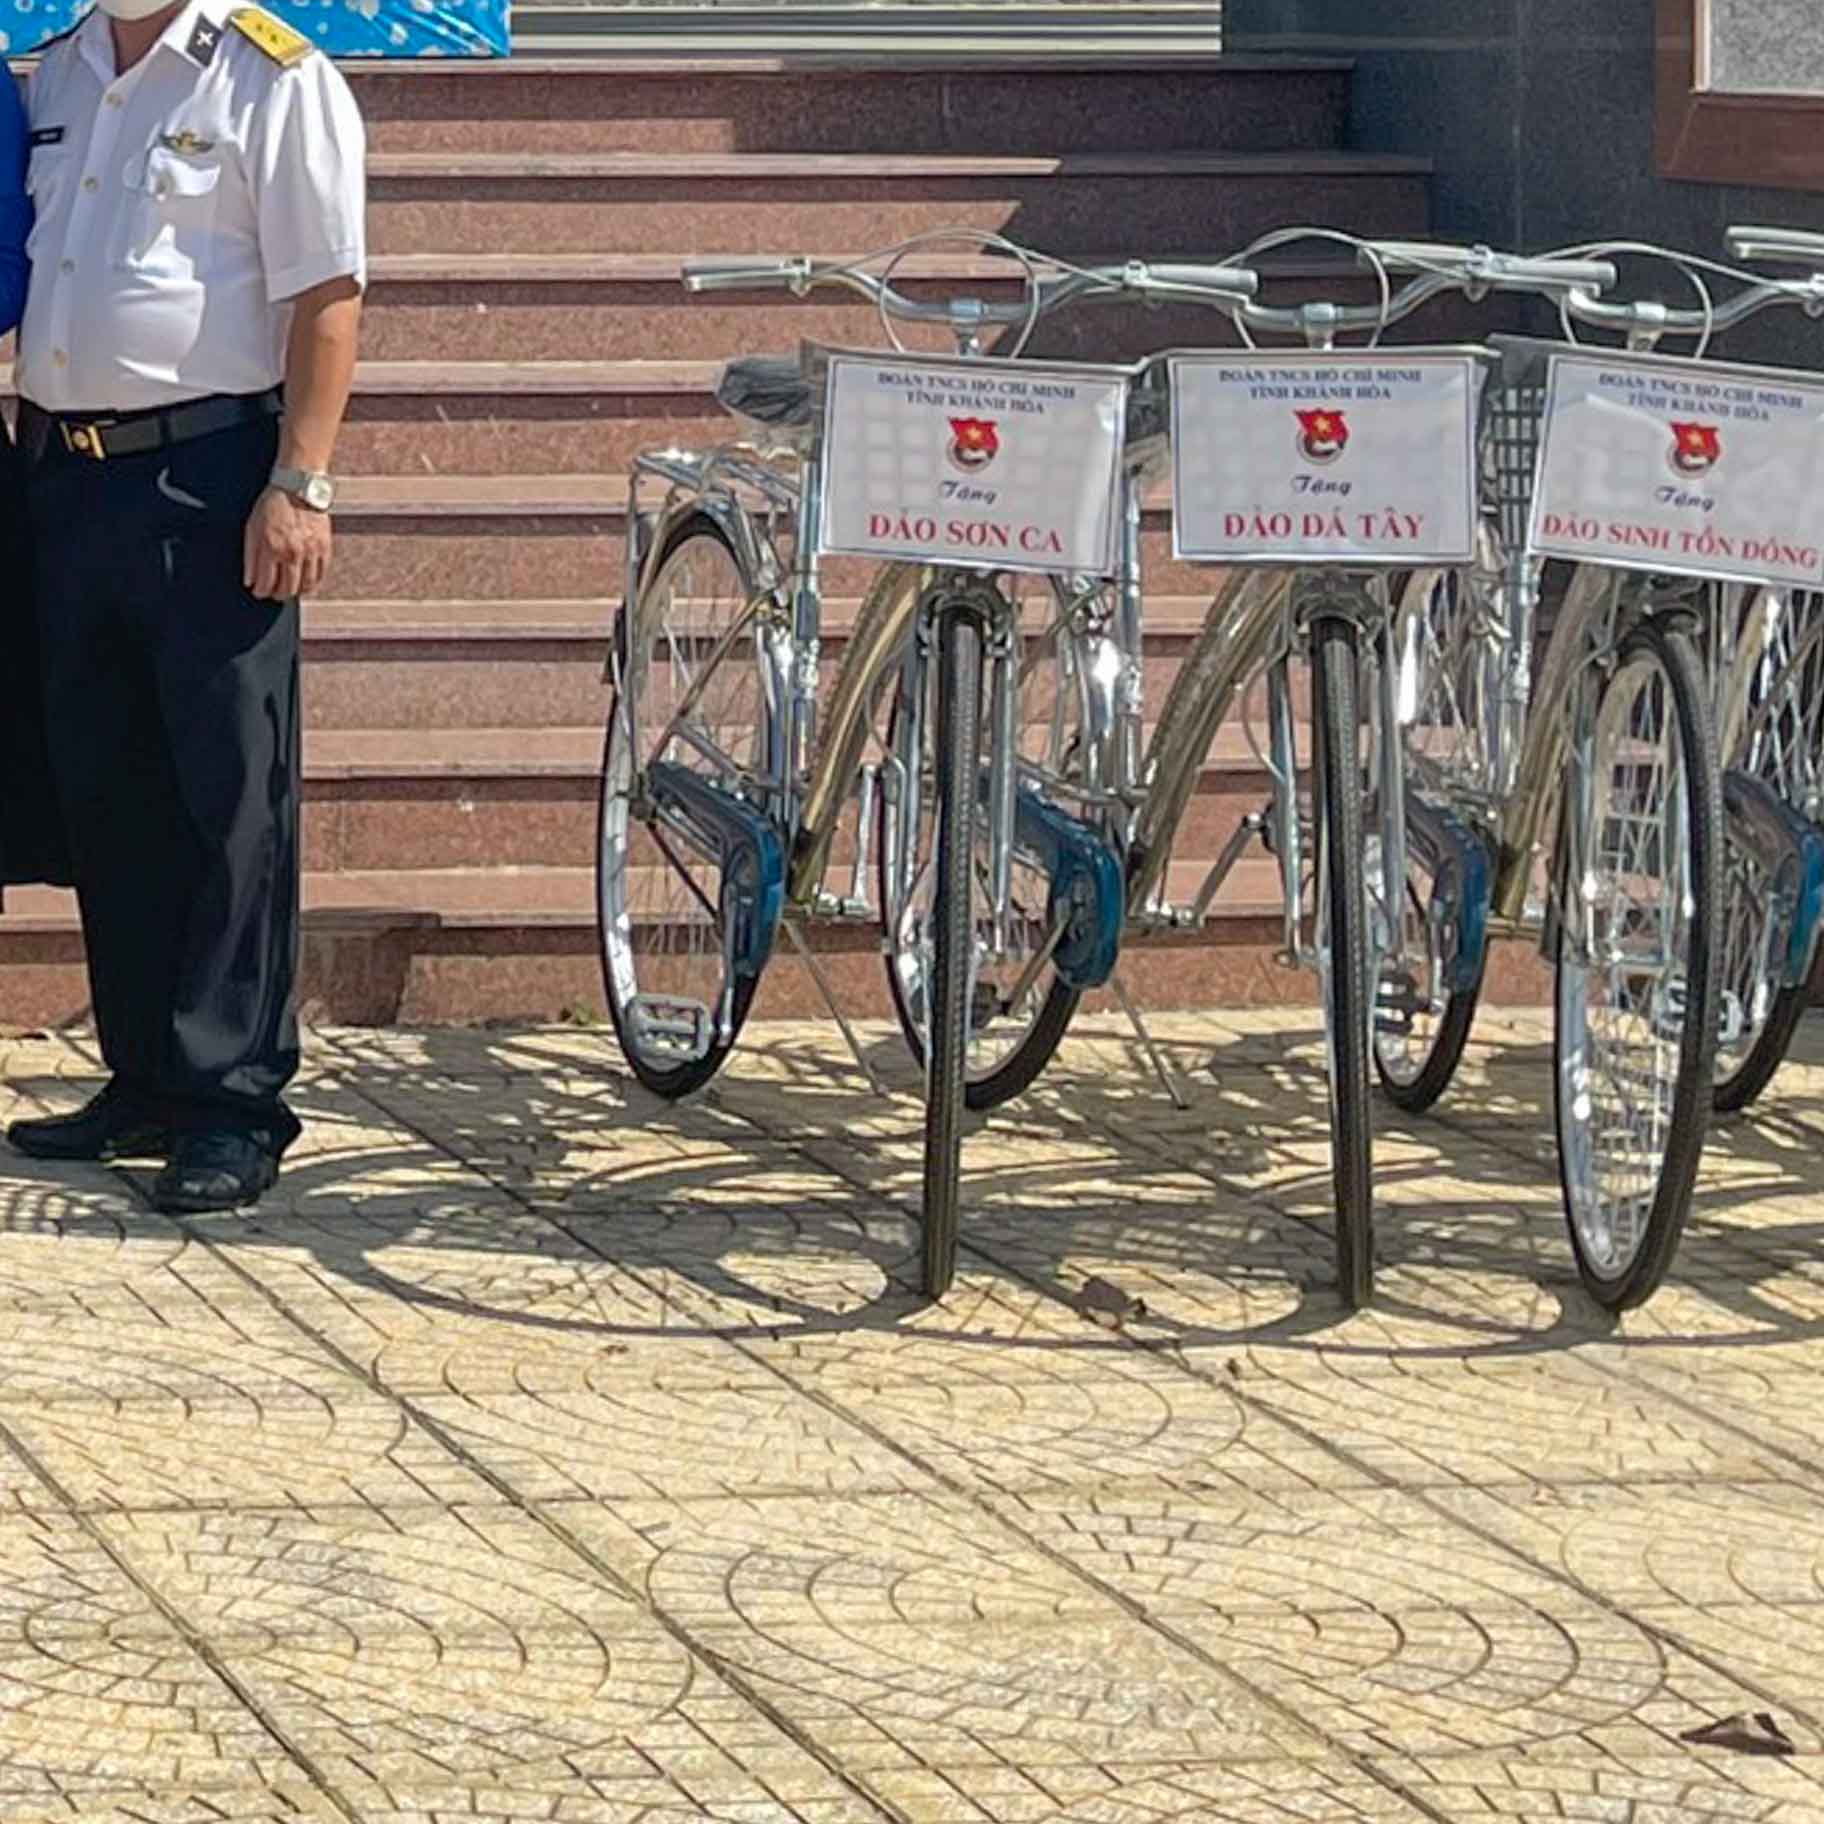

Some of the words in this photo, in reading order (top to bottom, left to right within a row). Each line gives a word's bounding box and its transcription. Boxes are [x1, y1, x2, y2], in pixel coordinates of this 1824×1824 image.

[870, 508, 936, 541] ĐẢO
[945, 519, 1011, 547] SƠN
[1020, 527, 1064, 553] CA
[1225, 505, 1291, 538] ĐẢO
[1358, 507, 1423, 539] TÂY
